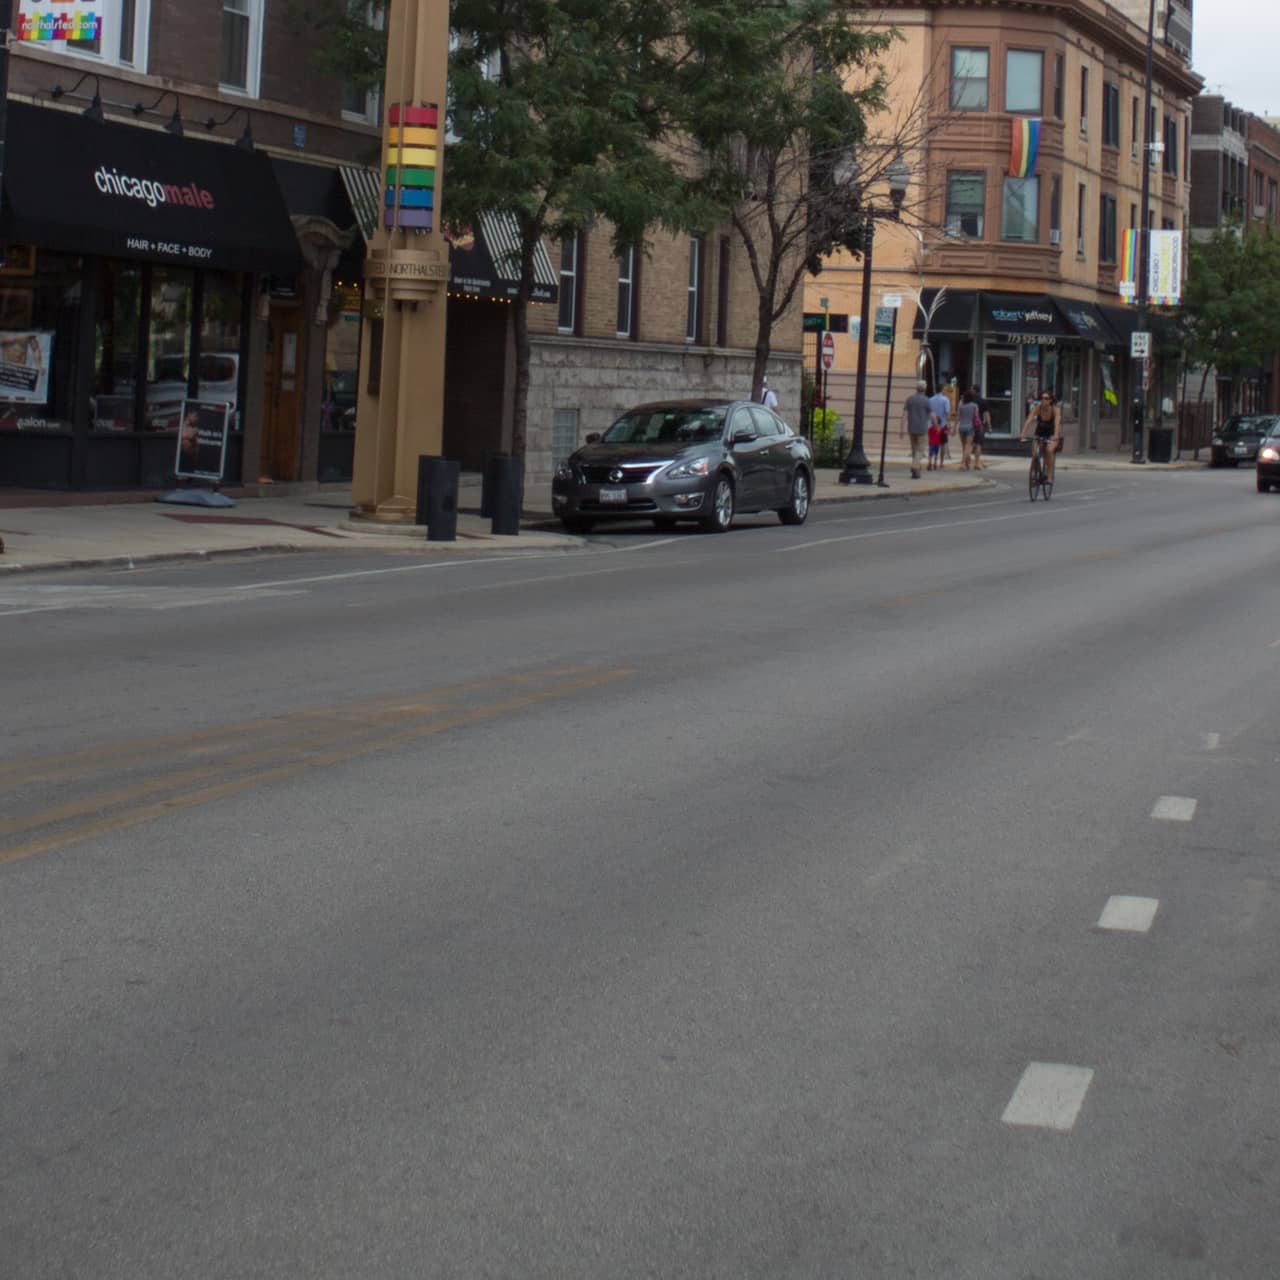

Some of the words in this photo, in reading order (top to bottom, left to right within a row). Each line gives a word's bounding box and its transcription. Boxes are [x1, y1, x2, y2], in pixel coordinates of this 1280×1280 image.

[94, 166, 215, 209] chicagomale
[127, 238, 149, 251] HAIR
[157, 242, 180, 254] FACE
[188, 246, 213, 258] BODY
